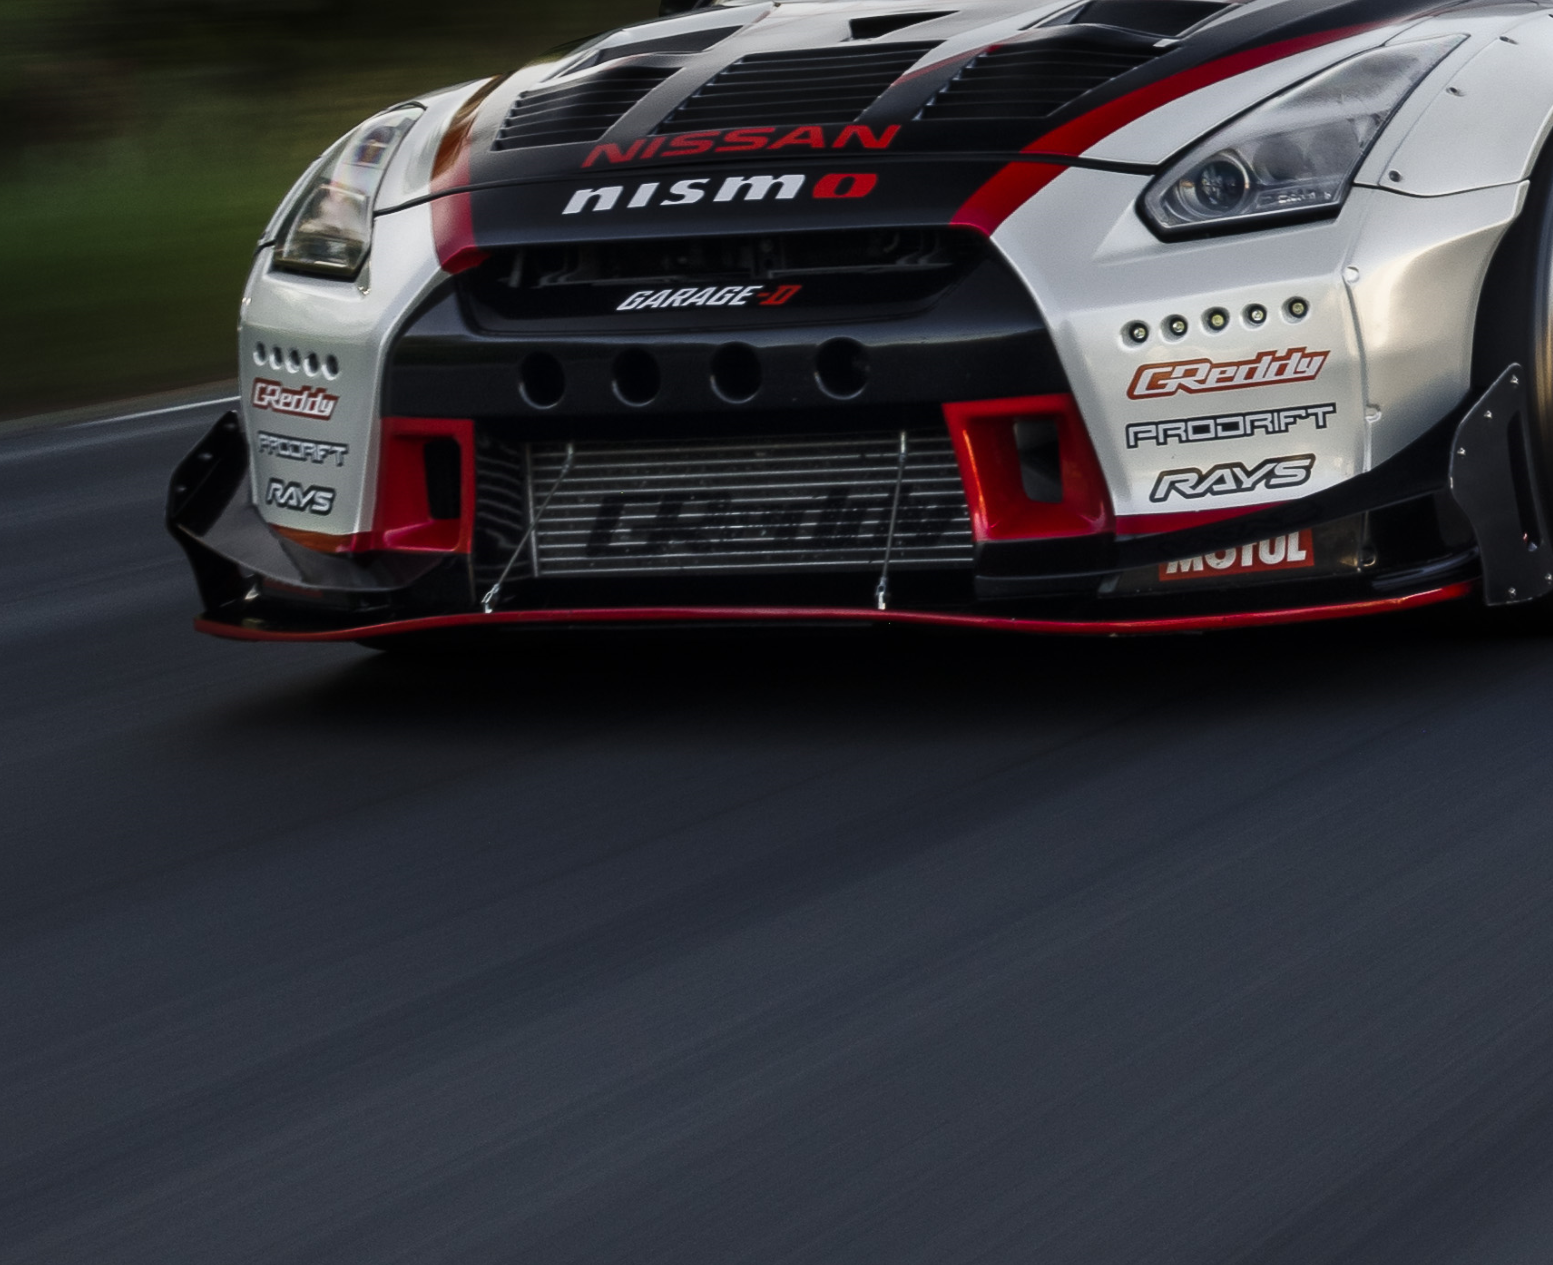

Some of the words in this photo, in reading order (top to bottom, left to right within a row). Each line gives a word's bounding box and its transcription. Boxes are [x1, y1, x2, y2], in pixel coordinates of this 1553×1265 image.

[581, 124, 901, 168] NISSAN
[616, 285, 802, 311] GARAGE-D
[1129, 348, 1329, 399] GReddy
[253, 378, 338, 420] GReddy
[1126, 403, 1336, 449] PRODRIFT
[266, 478, 335, 515] RAYS
[1150, 454, 1315, 502] RAYS
